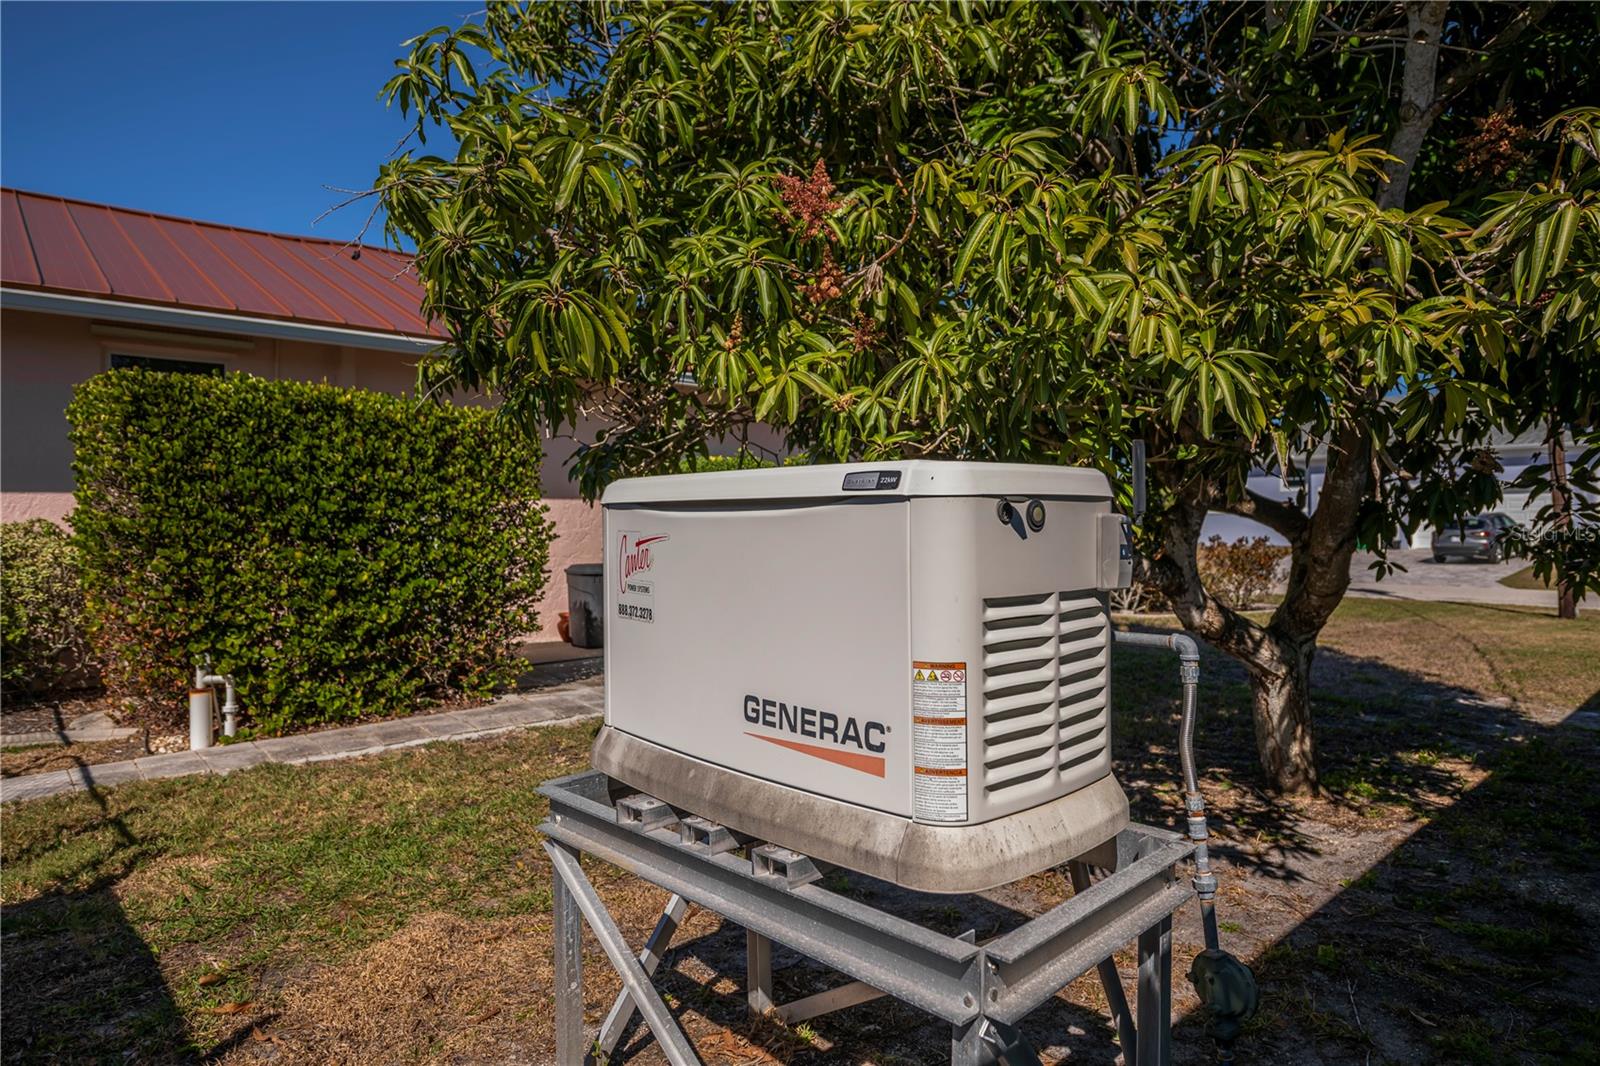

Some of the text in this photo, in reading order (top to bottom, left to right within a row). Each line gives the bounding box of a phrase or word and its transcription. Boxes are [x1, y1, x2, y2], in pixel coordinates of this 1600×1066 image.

[627, 583, 651, 594] POWER SYSTEMS
[618, 603, 653, 620] 888.372.3278
[743, 694, 886, 754] GENERAC
